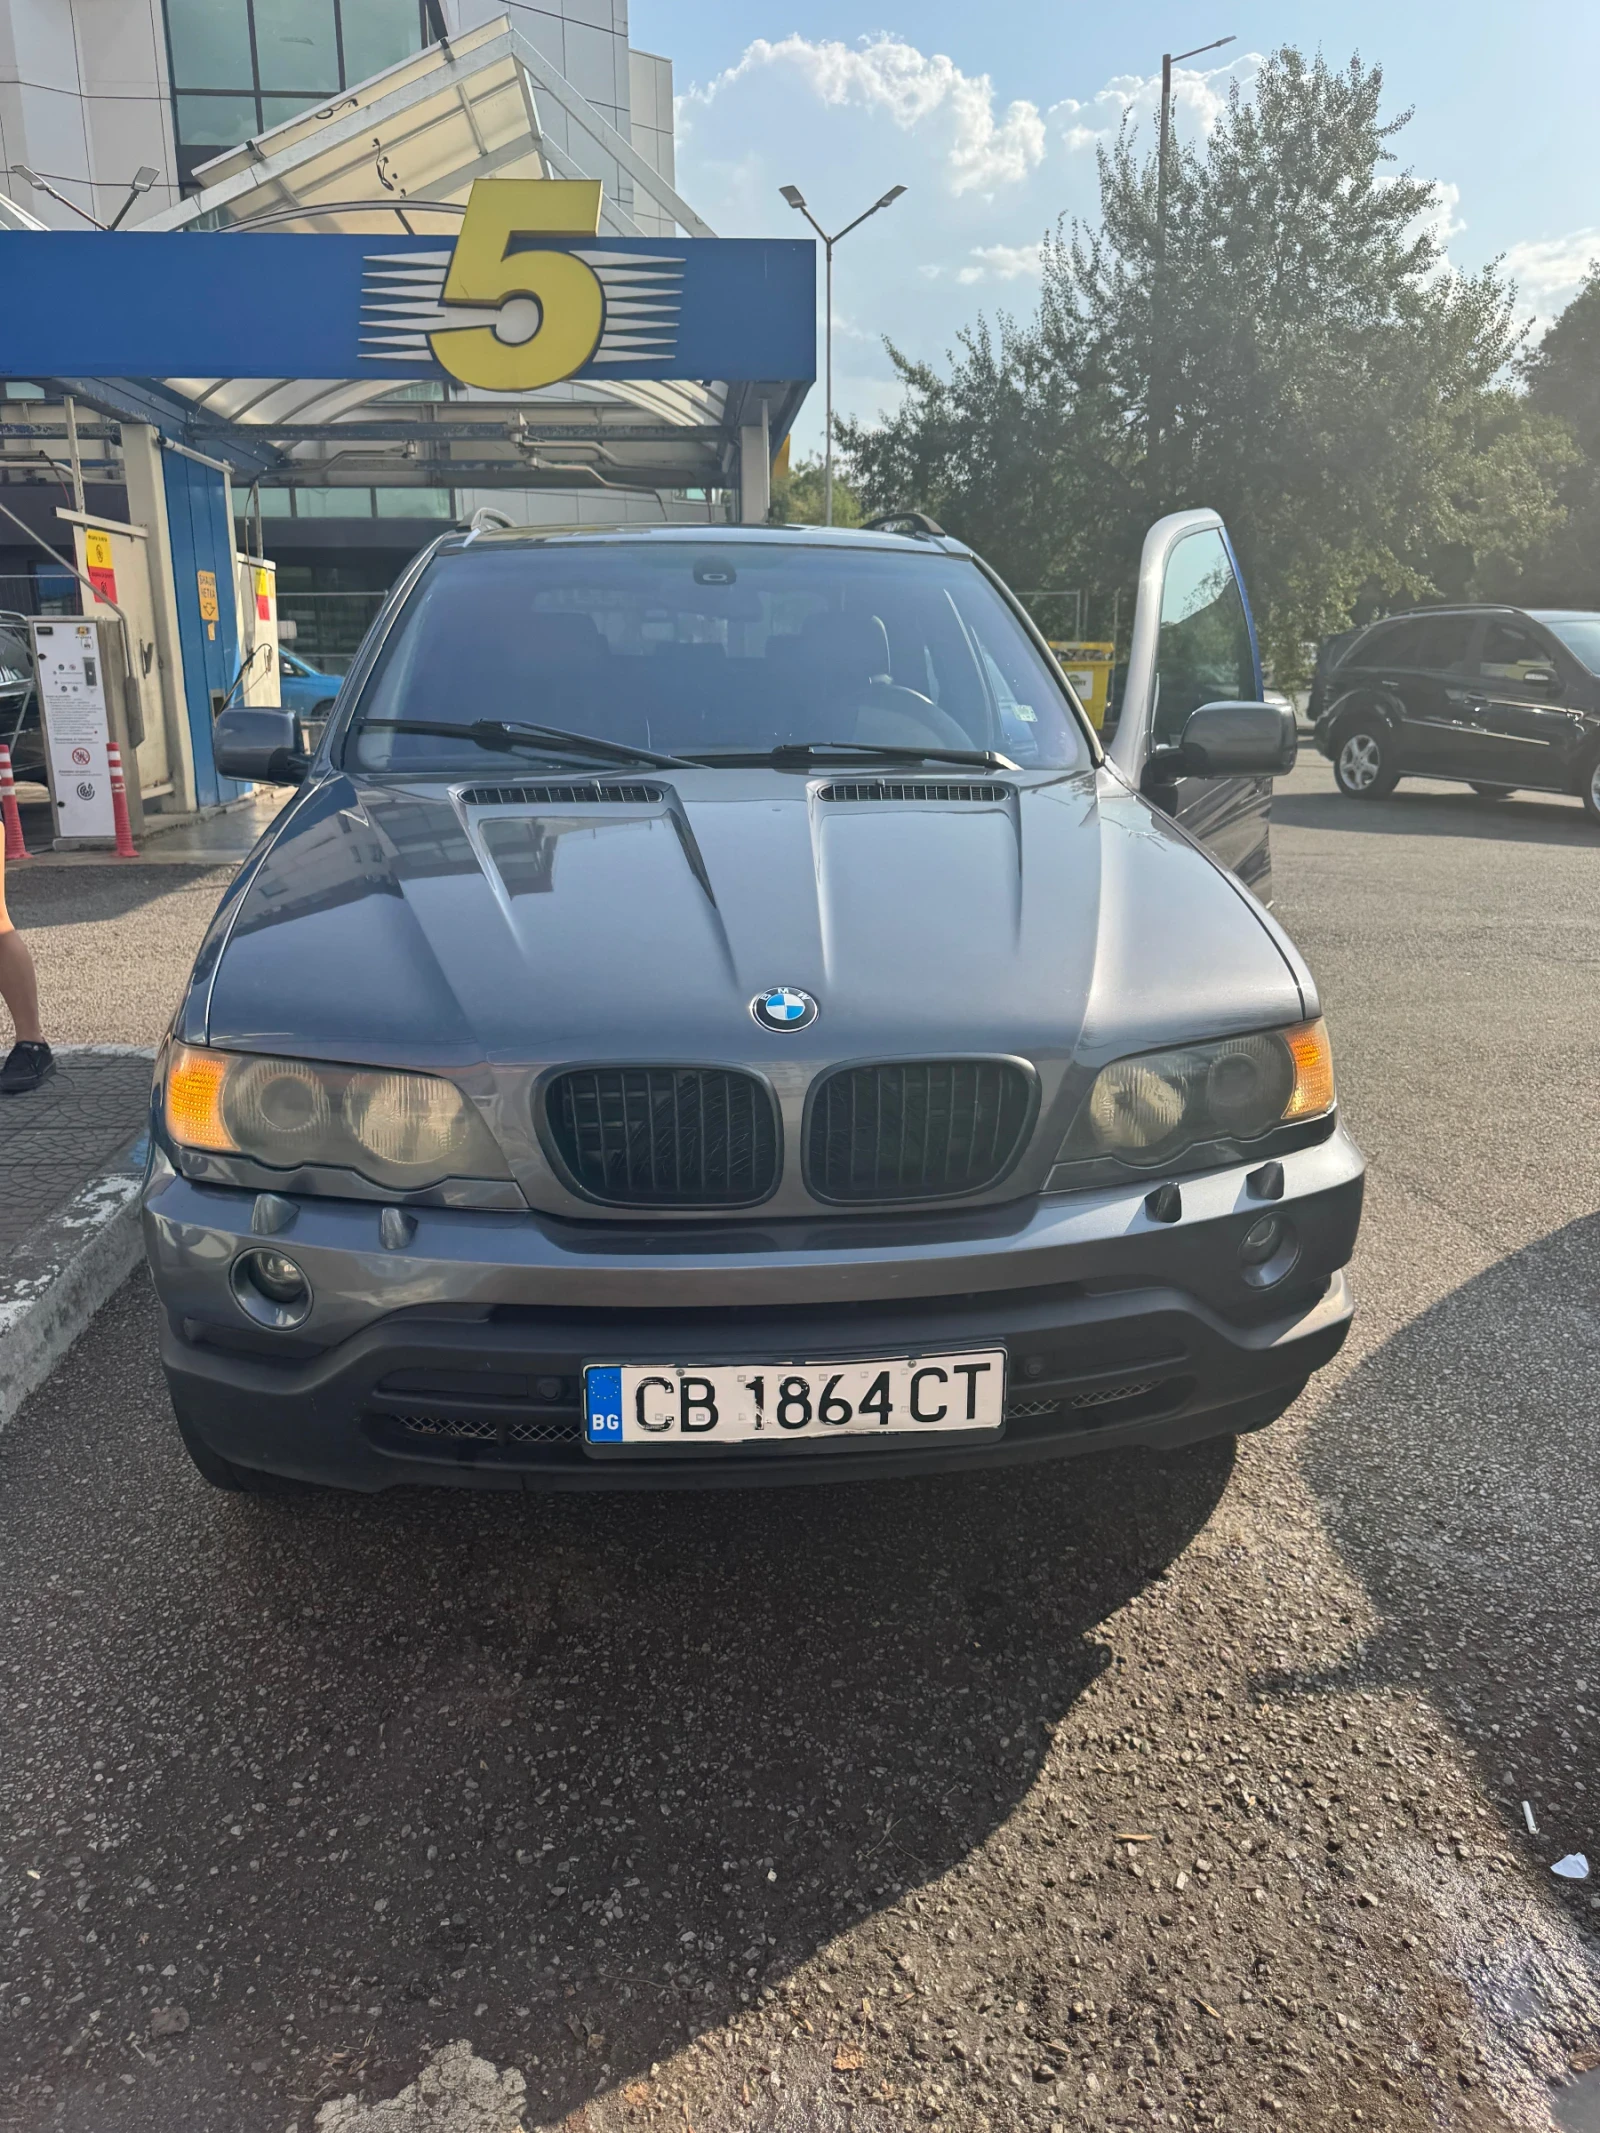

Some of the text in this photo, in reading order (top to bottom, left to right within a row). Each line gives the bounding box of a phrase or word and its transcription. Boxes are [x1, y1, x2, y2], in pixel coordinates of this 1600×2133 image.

[427, 178, 603, 391] 5
[760, 987, 811, 1001] BMW
[635, 1362, 991, 1433] CB 1864 CT
[592, 1413, 620, 1431] BG
